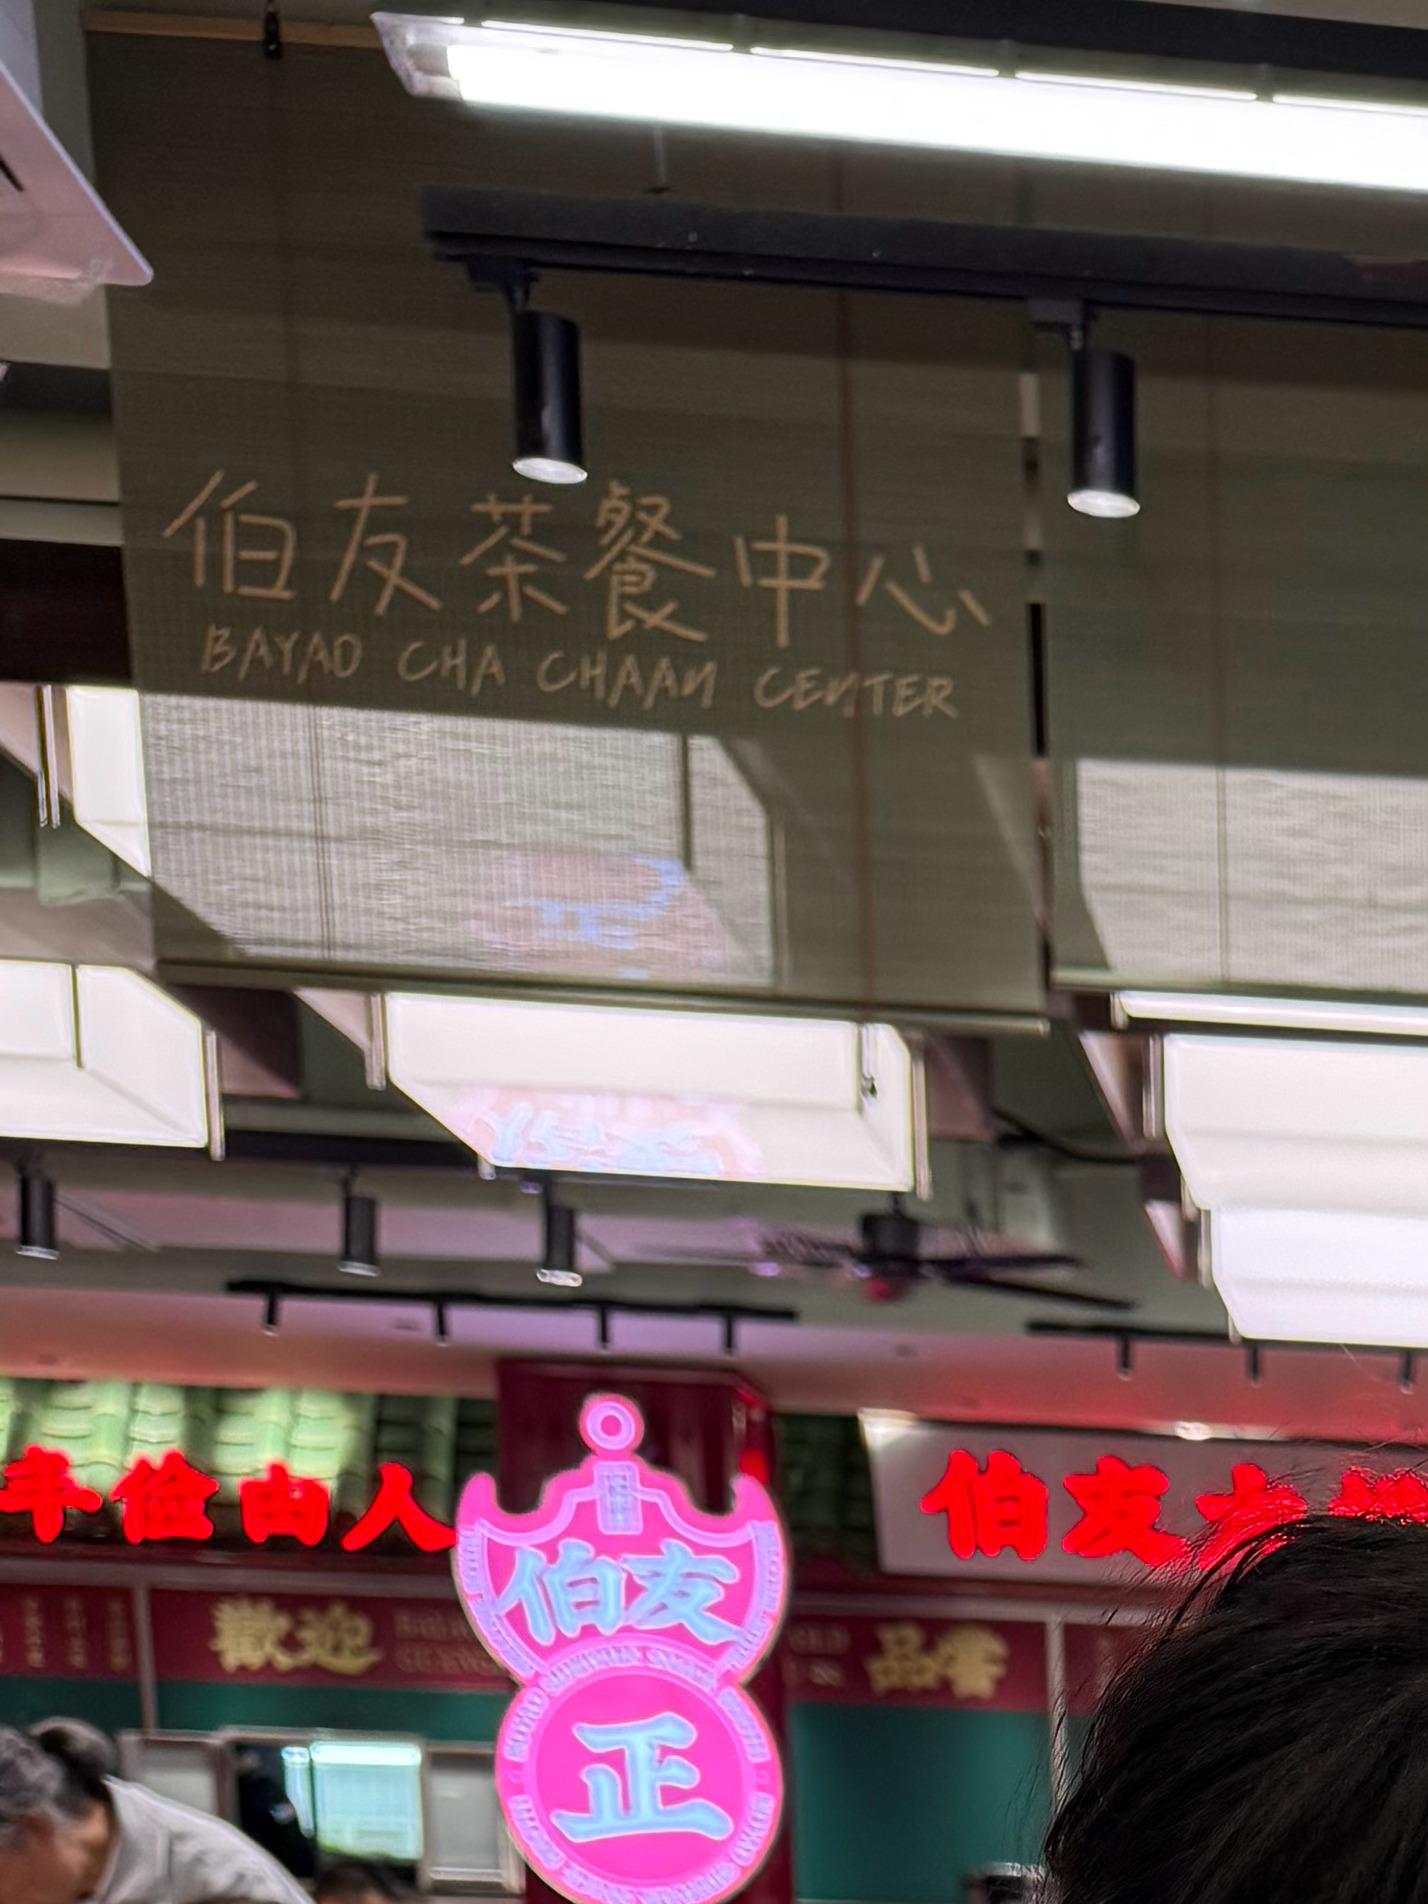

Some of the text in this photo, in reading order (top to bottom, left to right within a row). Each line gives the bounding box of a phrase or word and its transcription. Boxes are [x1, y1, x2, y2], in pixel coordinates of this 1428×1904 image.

[163, 470, 992, 650] 伯友茶餐中心
[200, 624, 959, 720] BAYAO CHA CHAAN CENTER
[492, 1536, 745, 1645] 伯友
[552, 1710, 735, 1845] 正
